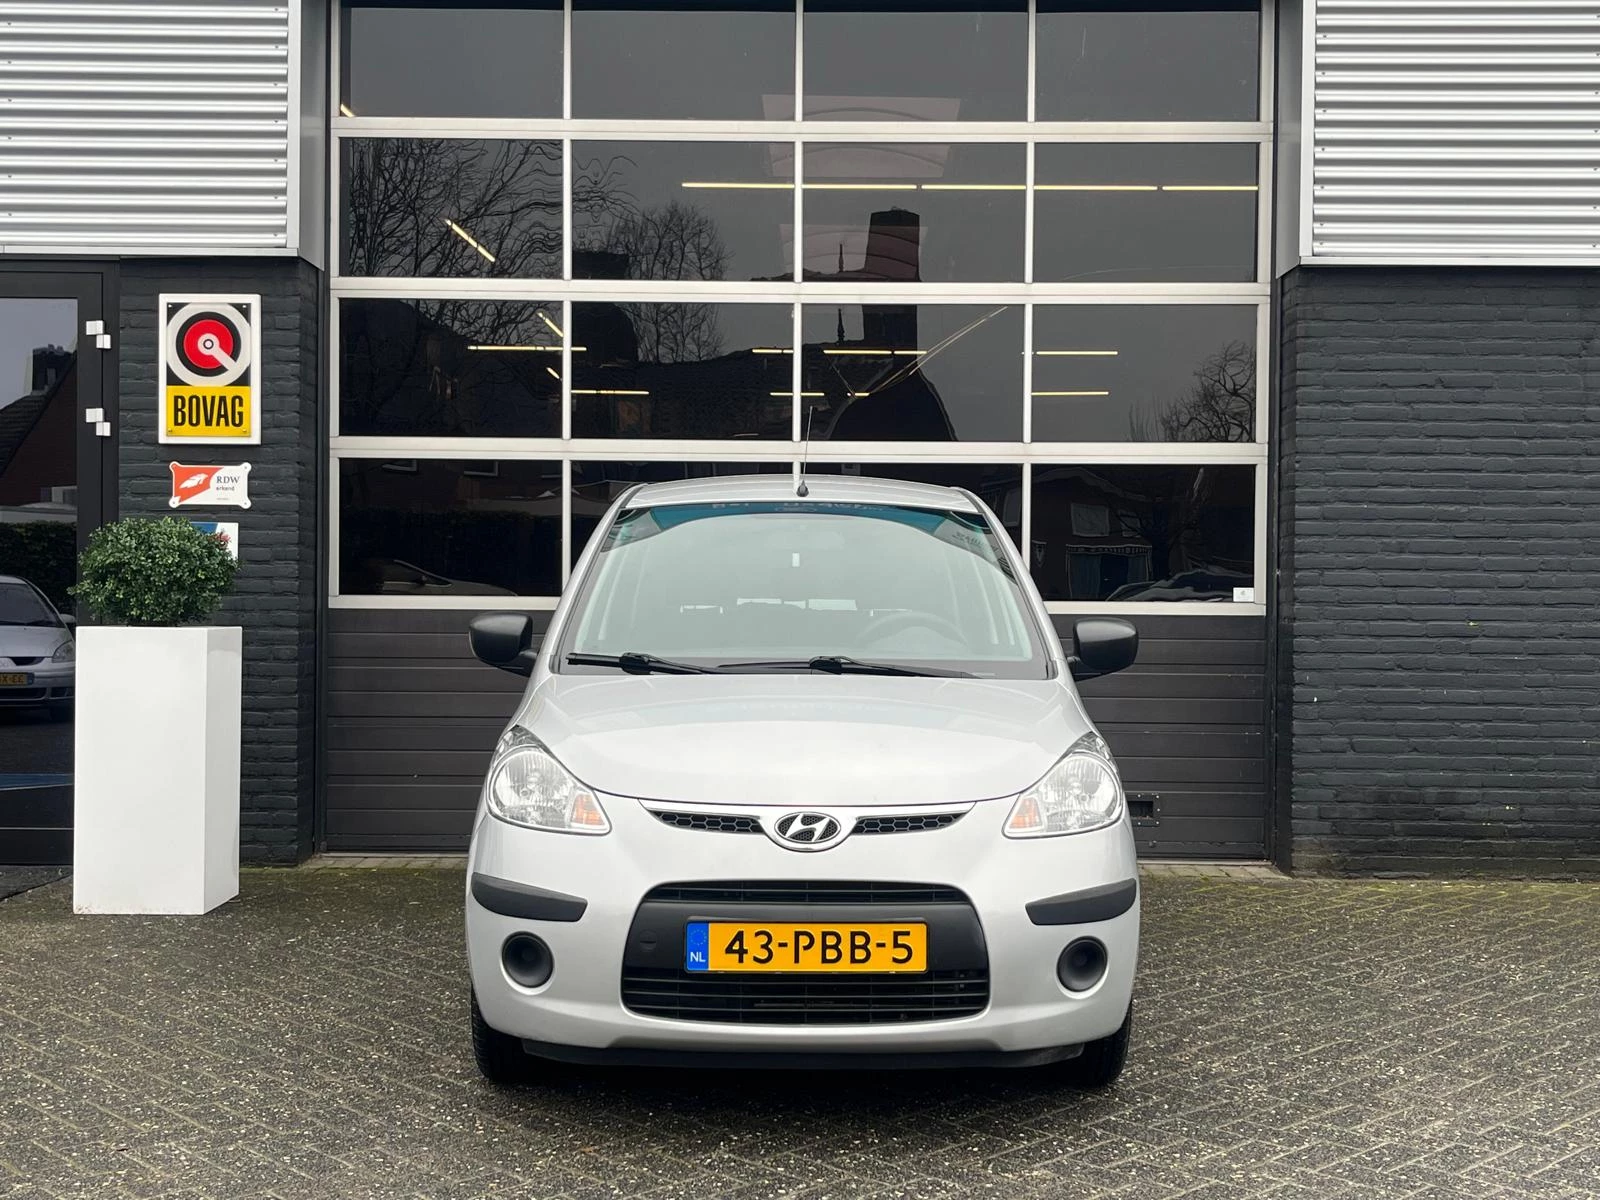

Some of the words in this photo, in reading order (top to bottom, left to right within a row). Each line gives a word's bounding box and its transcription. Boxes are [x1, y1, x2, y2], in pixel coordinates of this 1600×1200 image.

[173, 395, 244, 428] BOVAG
[216, 475, 240, 484] RDW
[690, 951, 706, 962] NL
[724, 930, 913, 964] 43-PBB-5
